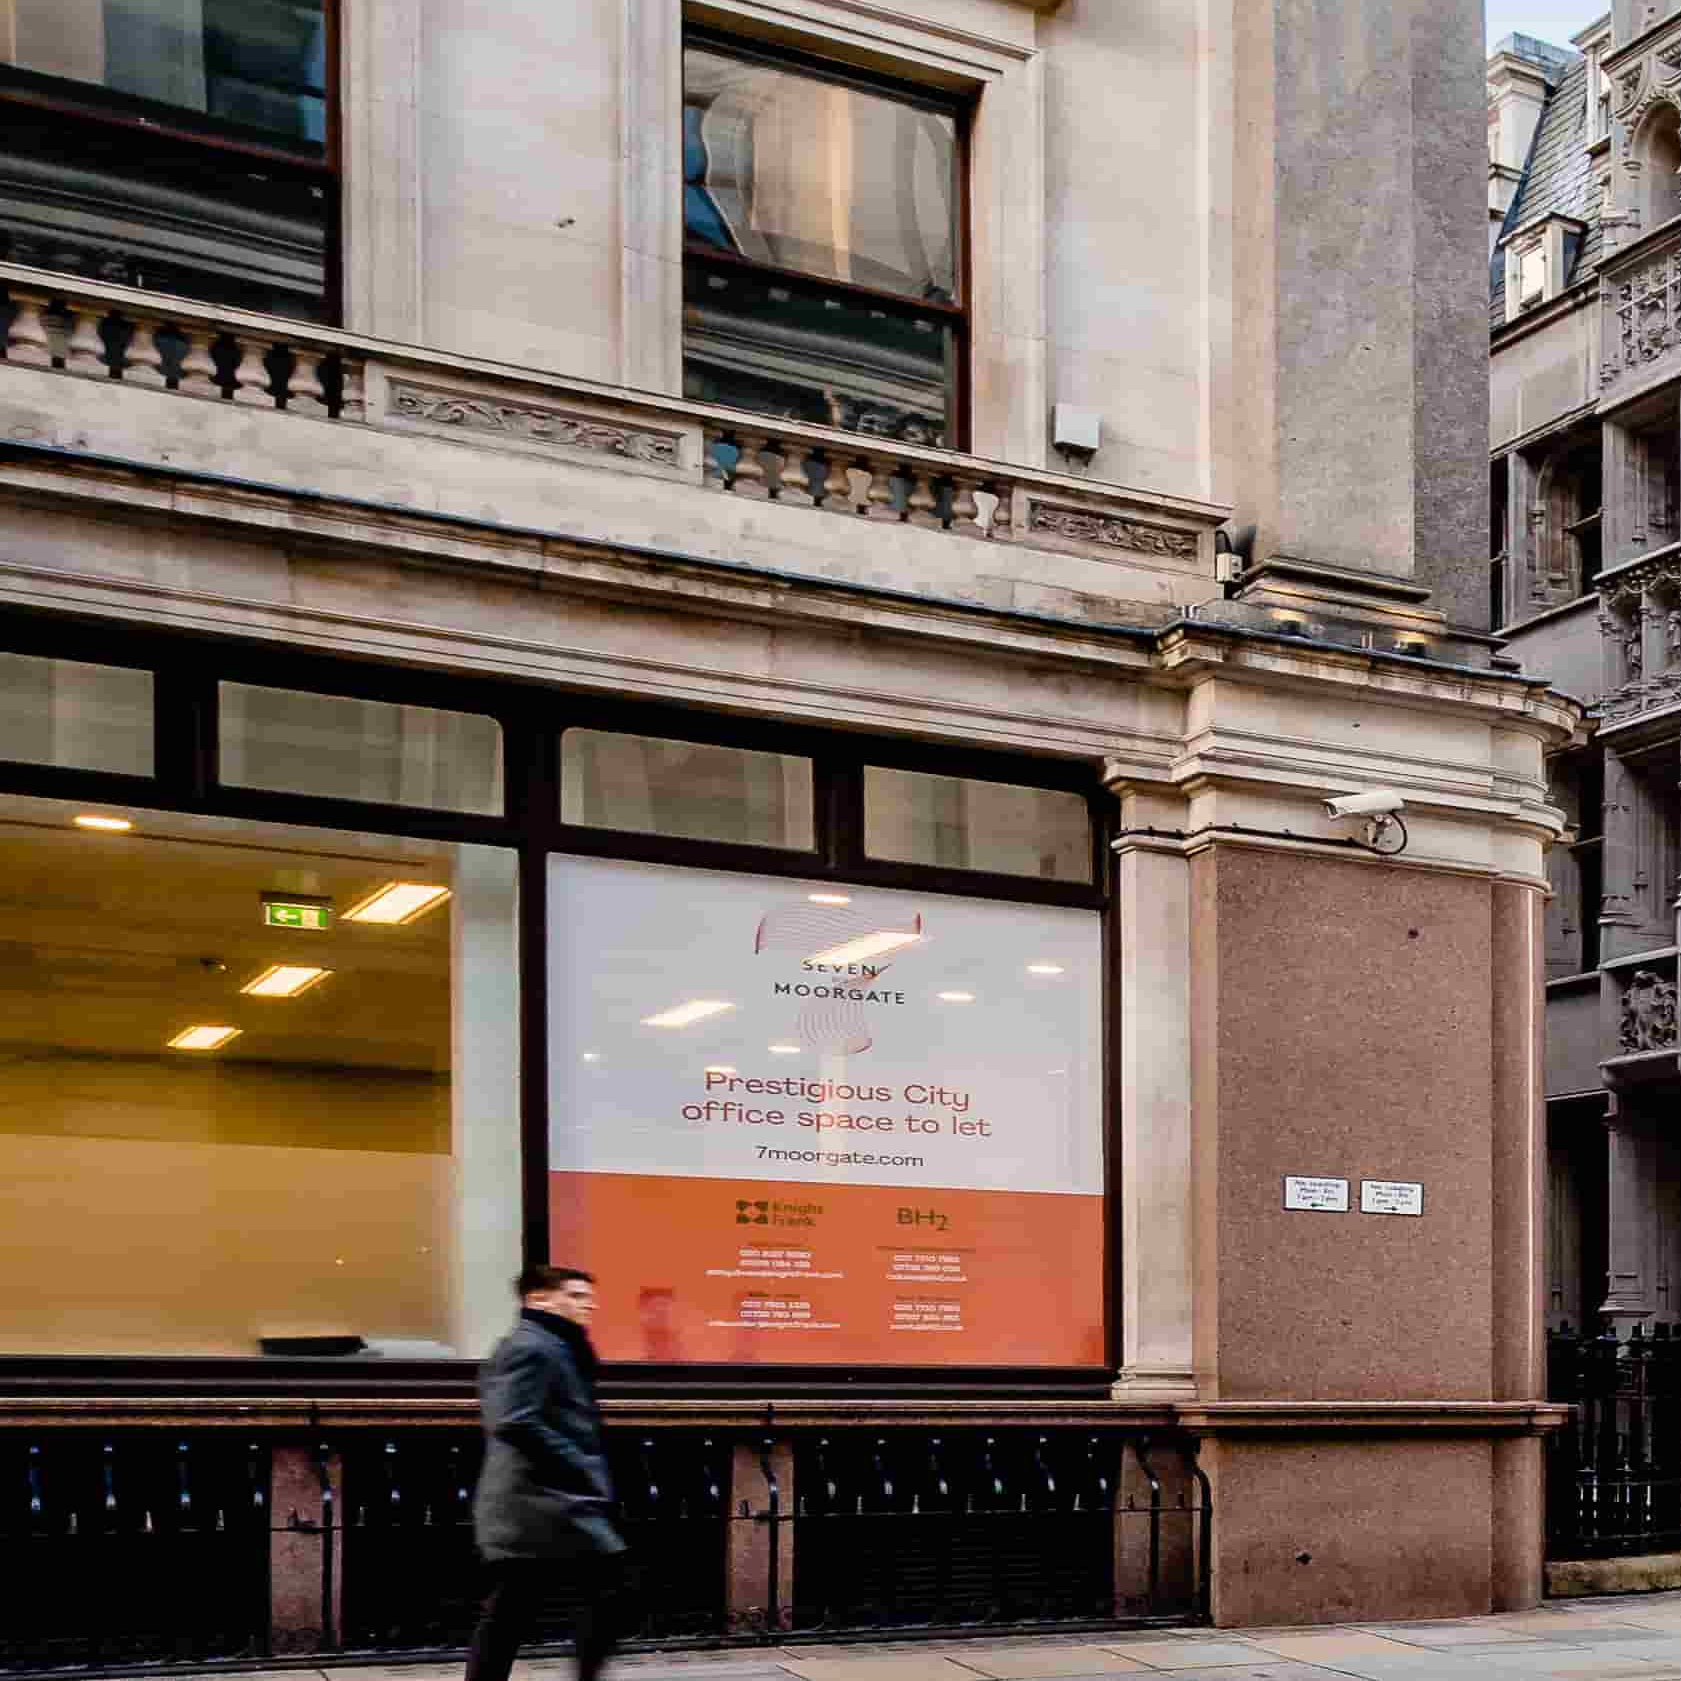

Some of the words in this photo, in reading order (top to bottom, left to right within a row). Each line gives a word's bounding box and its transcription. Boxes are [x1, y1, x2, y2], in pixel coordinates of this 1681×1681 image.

[802, 959, 876, 976] SEVEN
[774, 982, 905, 1005] MOORGATE
[704, 1071, 893, 1103] Prestigious
[903, 1084, 970, 1112] City
[681, 1101, 785, 1125] office
[797, 1111, 894, 1133] space
[904, 1115, 940, 1134] to
[952, 1116, 992, 1137] let
[755, 1146, 925, 1167] 7moorgate.com
